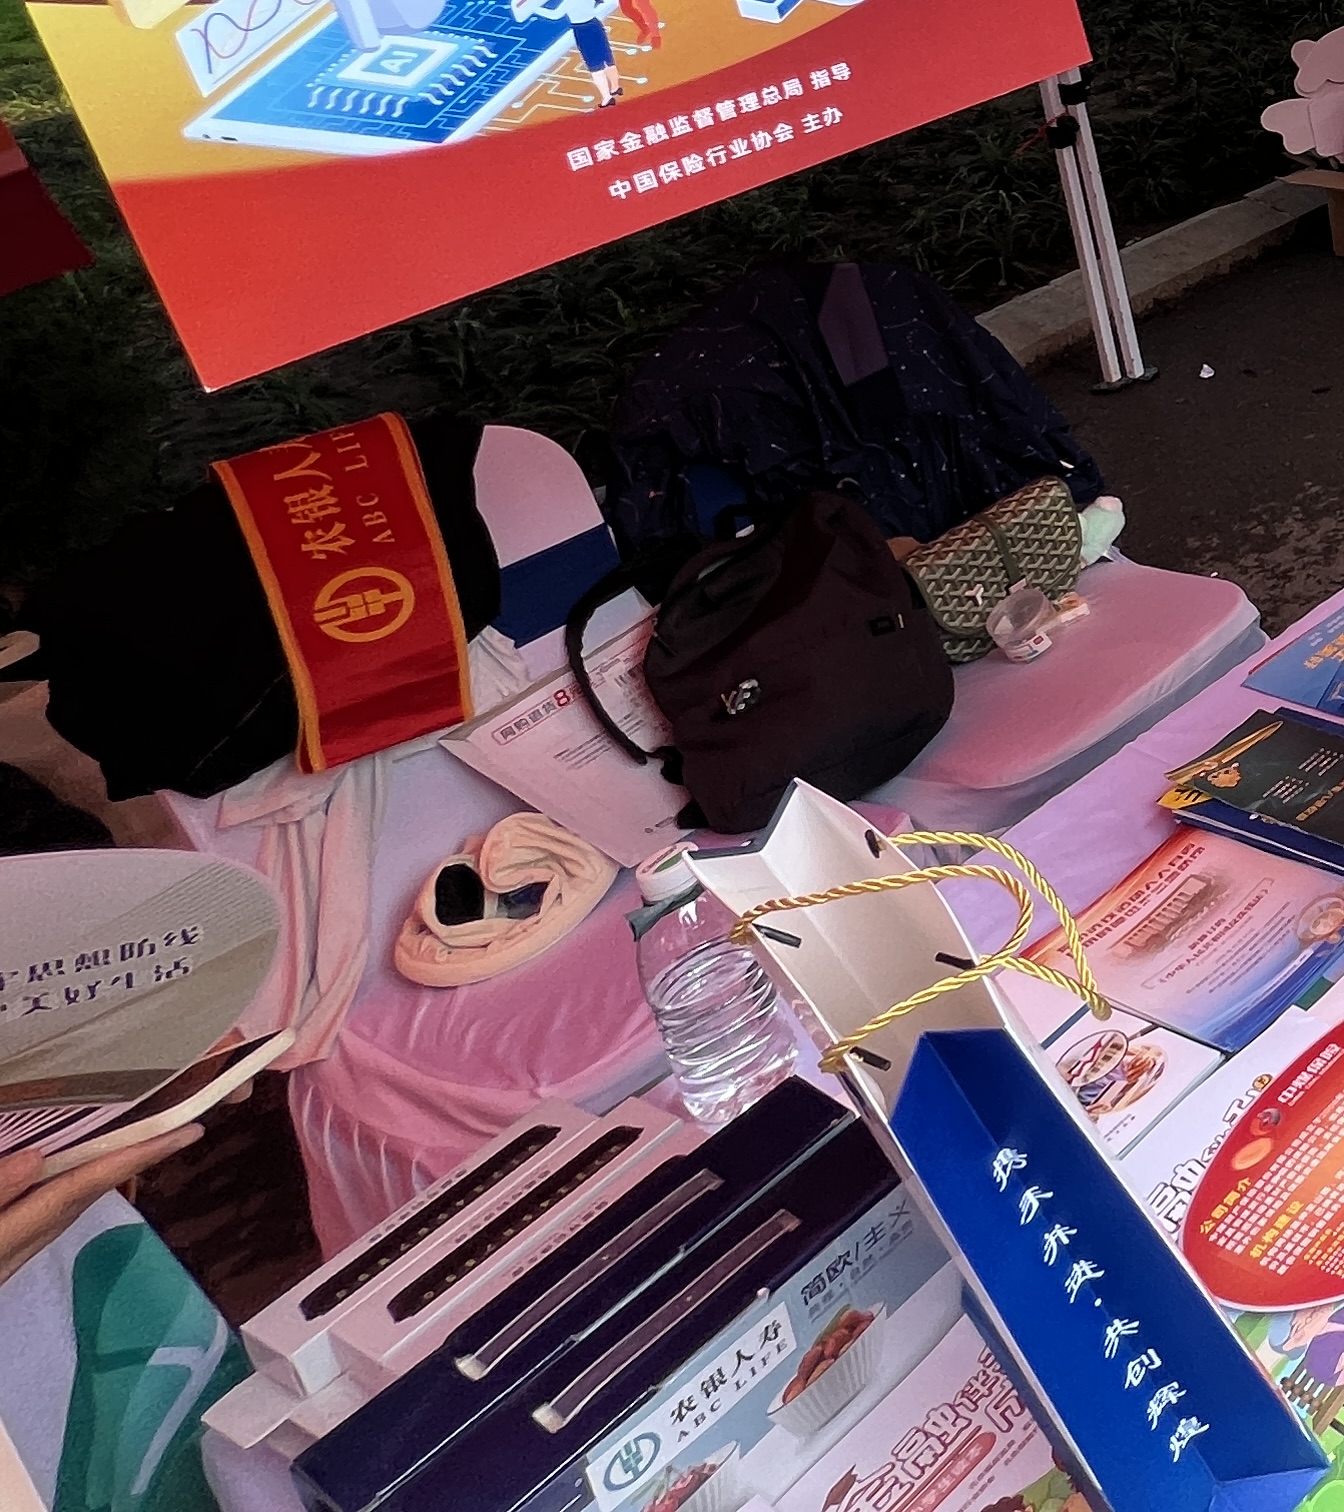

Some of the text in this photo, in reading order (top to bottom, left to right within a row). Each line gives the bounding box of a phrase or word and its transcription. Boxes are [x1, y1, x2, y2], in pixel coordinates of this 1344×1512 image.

[567, 62, 853, 173] 国家金融监督管理总局 指导
[608, 105, 845, 200] 中国保险行业协会 主办
[359, 494, 395, 543] ABC
[1277, 1039, 1341, 1108] 中煤保险
[1196, 1175, 1253, 1237] 公司简介
[670, 1320, 785, 1425] 农银人寿
[677, 1338, 790, 1442] ABC LIFE
